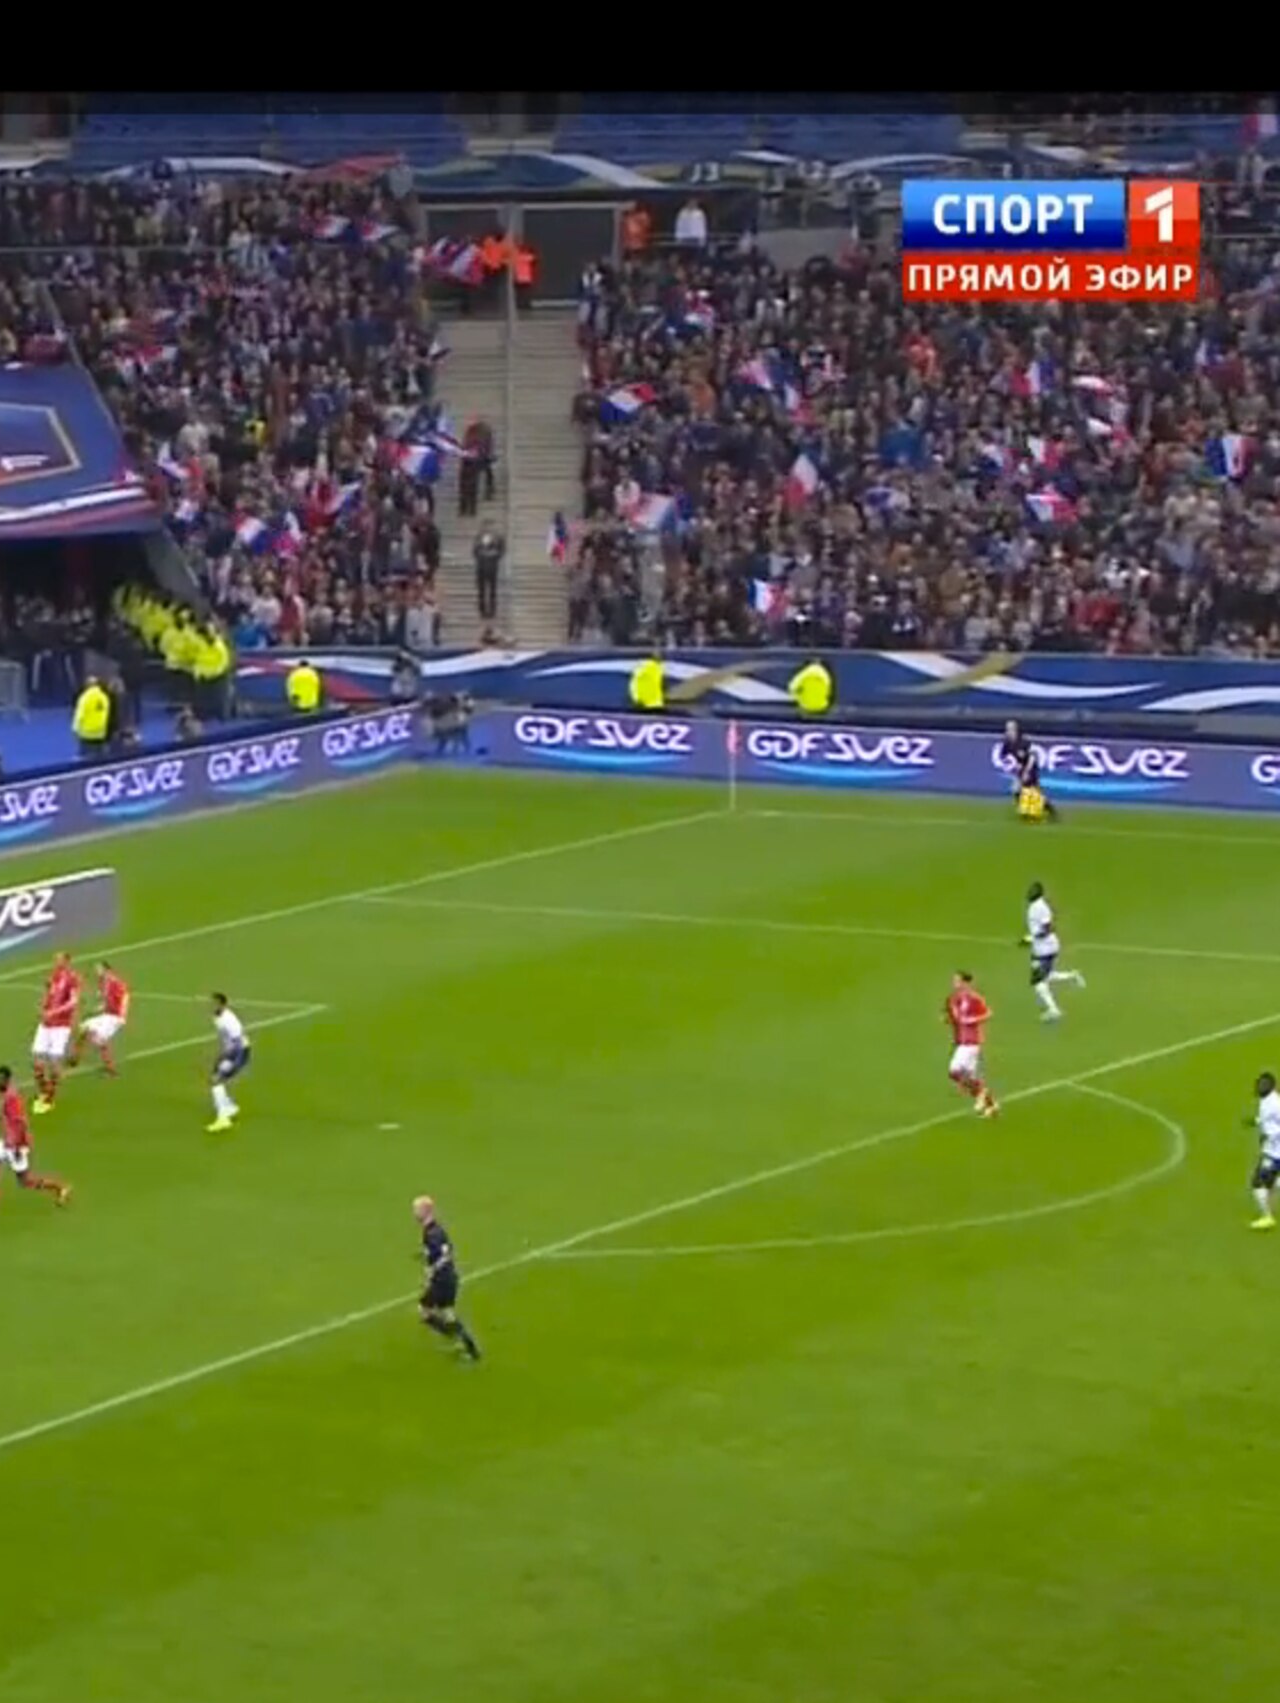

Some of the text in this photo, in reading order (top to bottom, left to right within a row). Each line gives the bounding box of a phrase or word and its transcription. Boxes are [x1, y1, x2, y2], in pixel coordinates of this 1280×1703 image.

[515, 716, 588, 746] GDF
[748, 729, 823, 759] GDF
[85, 771, 127, 805] GDF
